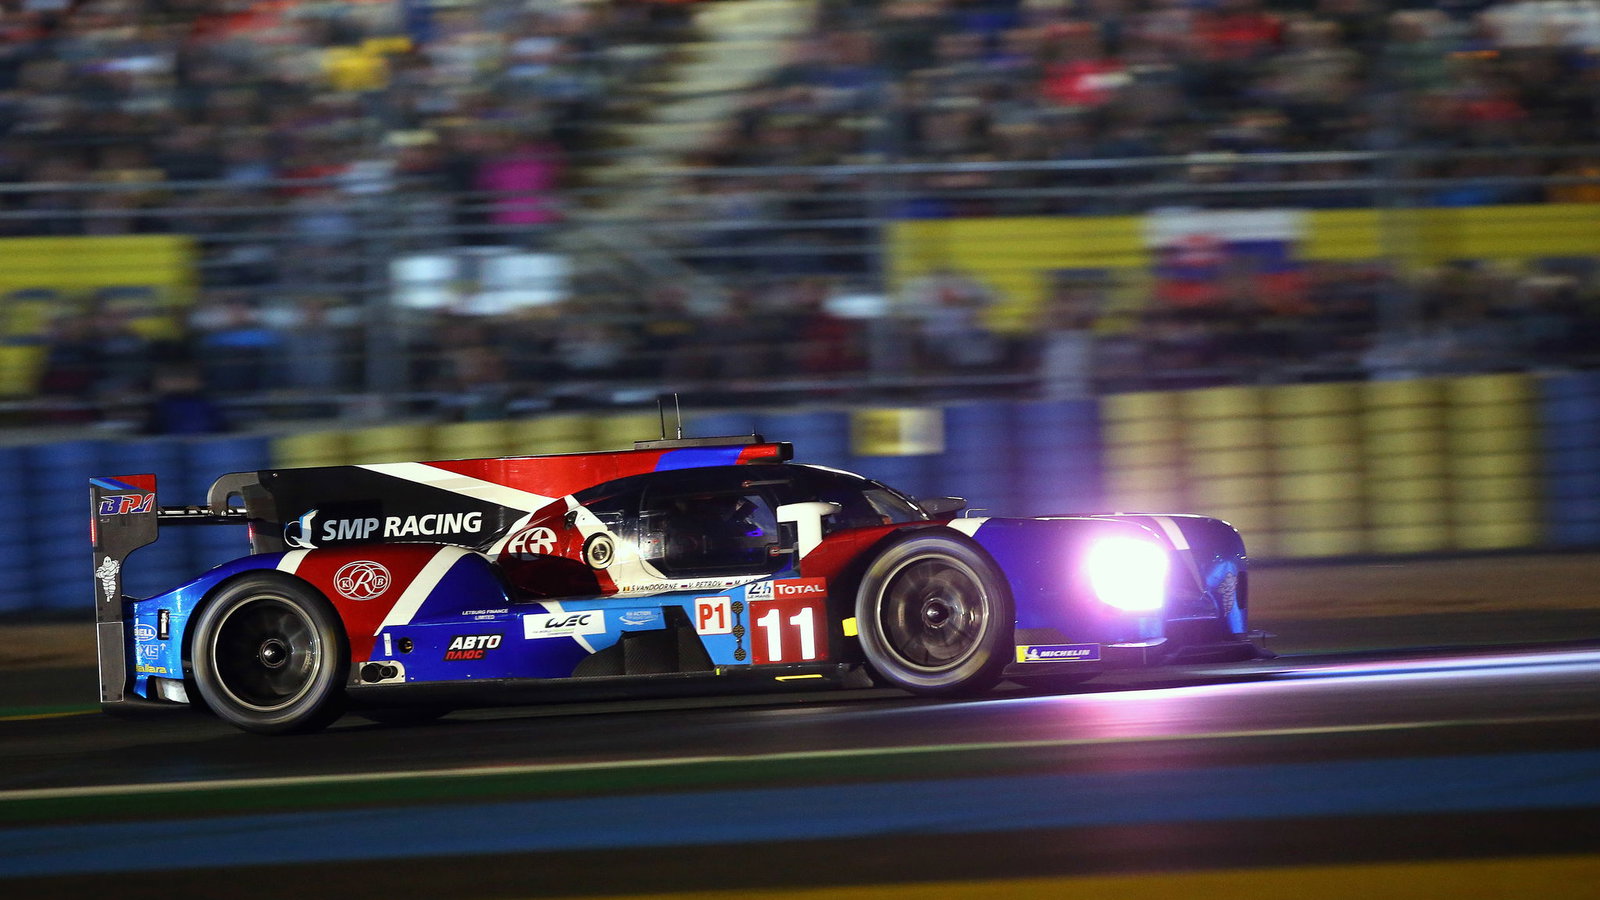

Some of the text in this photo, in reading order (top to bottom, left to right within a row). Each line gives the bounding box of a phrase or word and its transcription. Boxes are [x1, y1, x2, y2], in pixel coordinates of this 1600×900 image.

[322, 512, 483, 541] SMP RACING
[776, 584, 824, 595] TOTAL
[545, 614, 592, 628] WEC
[700, 603, 725, 630] P1
[757, 607, 816, 662] 11
[449, 635, 502, 651] АВТО
[445, 650, 484, 660] ПЛЮС
[1040, 649, 1091, 657] MICHELIN
